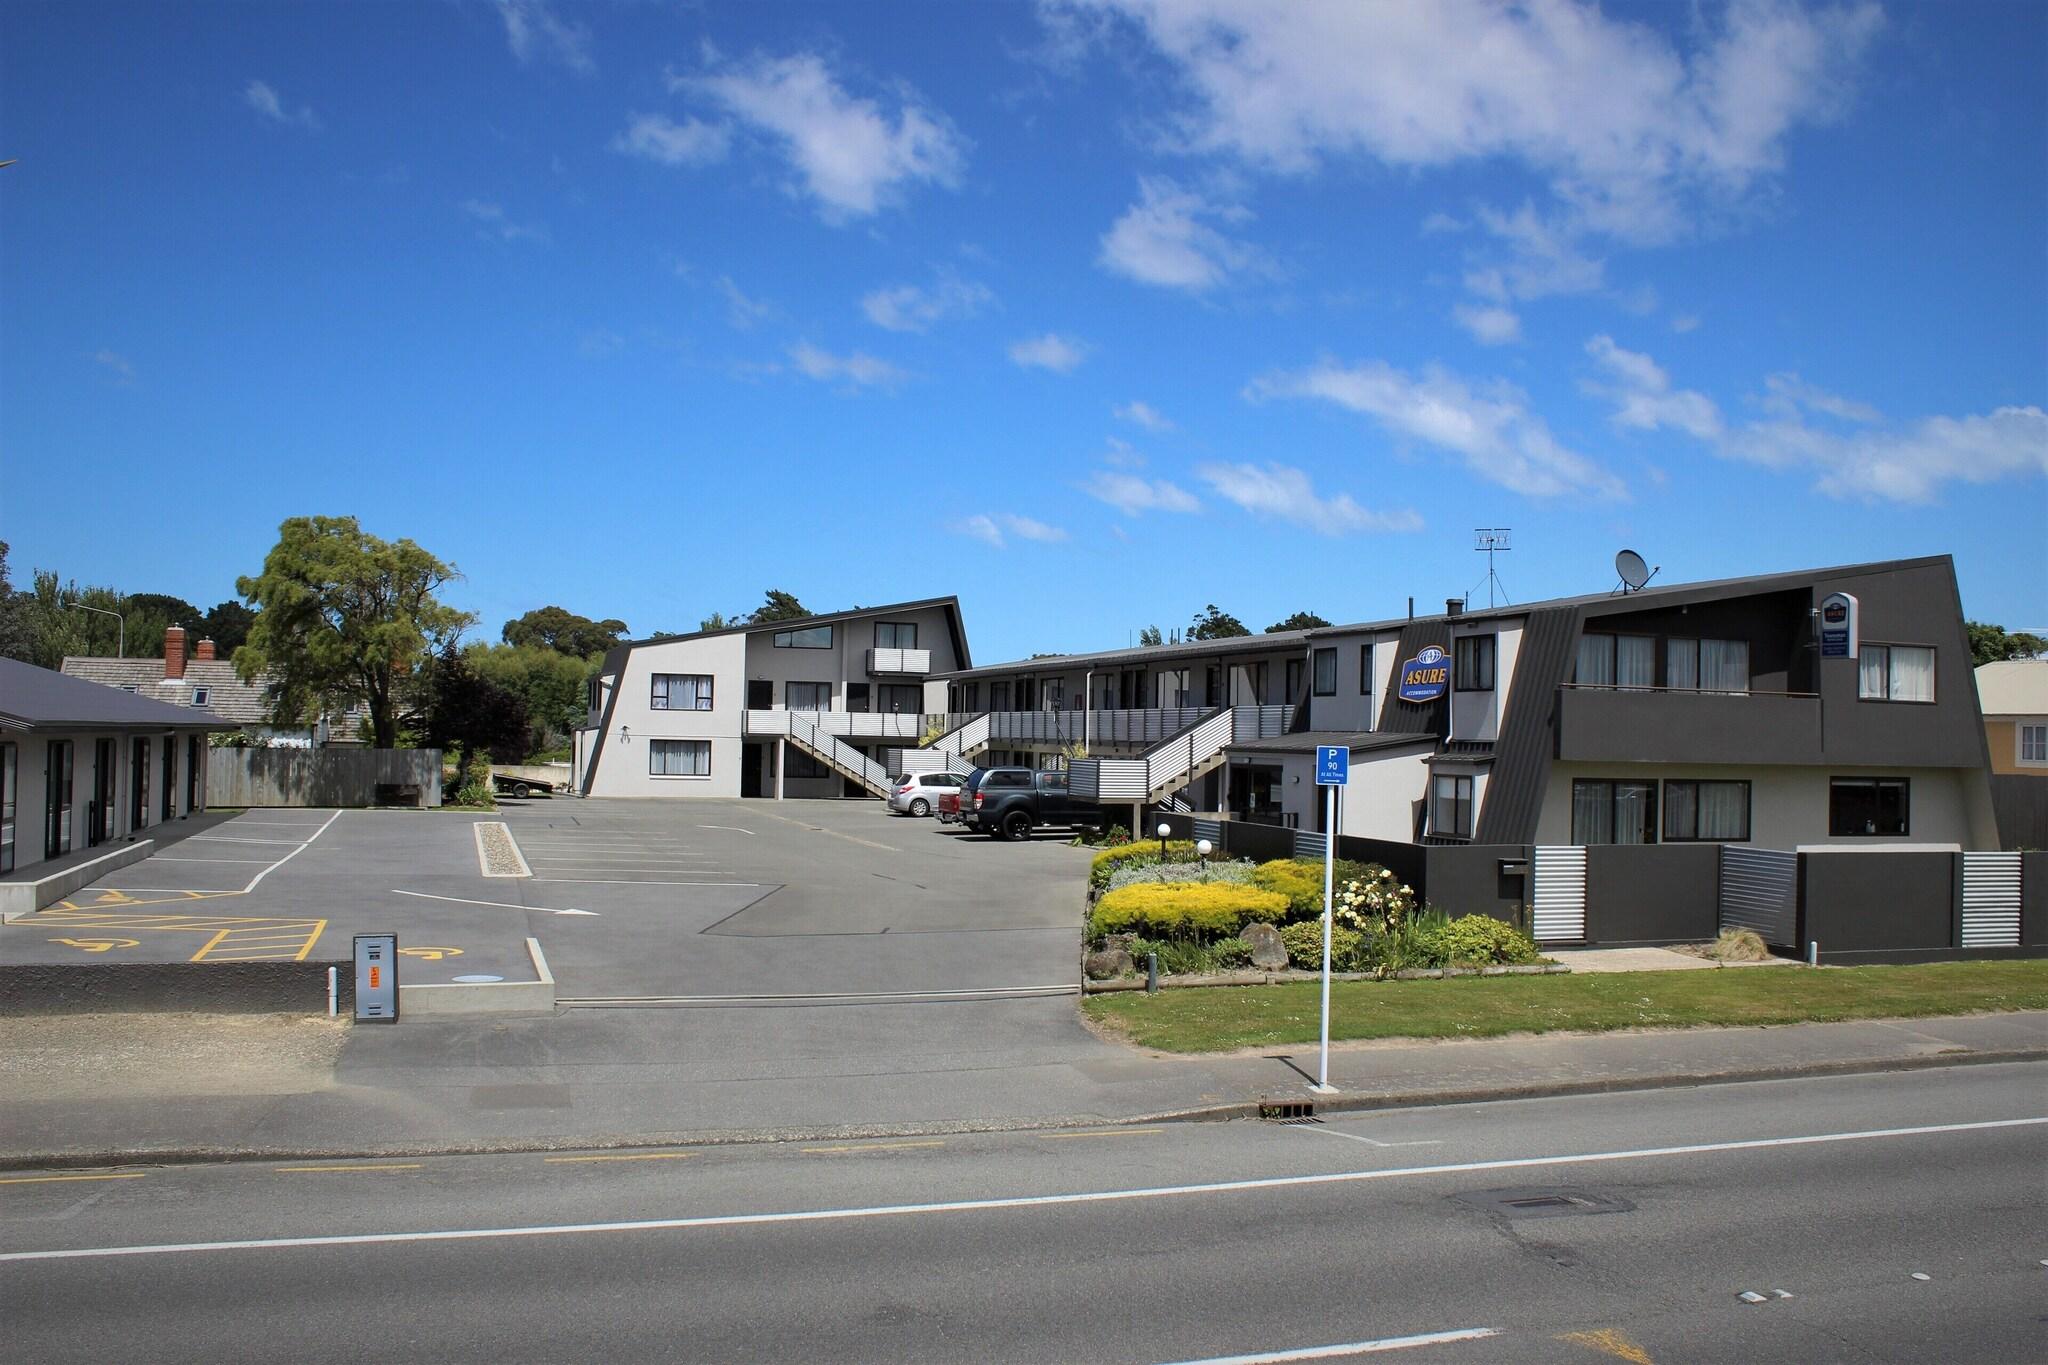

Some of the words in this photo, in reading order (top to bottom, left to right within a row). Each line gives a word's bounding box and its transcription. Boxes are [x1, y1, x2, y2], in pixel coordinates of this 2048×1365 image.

[1405, 668, 1447, 685] ASURE
[1328, 749, 1338, 760] P
[1327, 761, 1338, 770] 90
